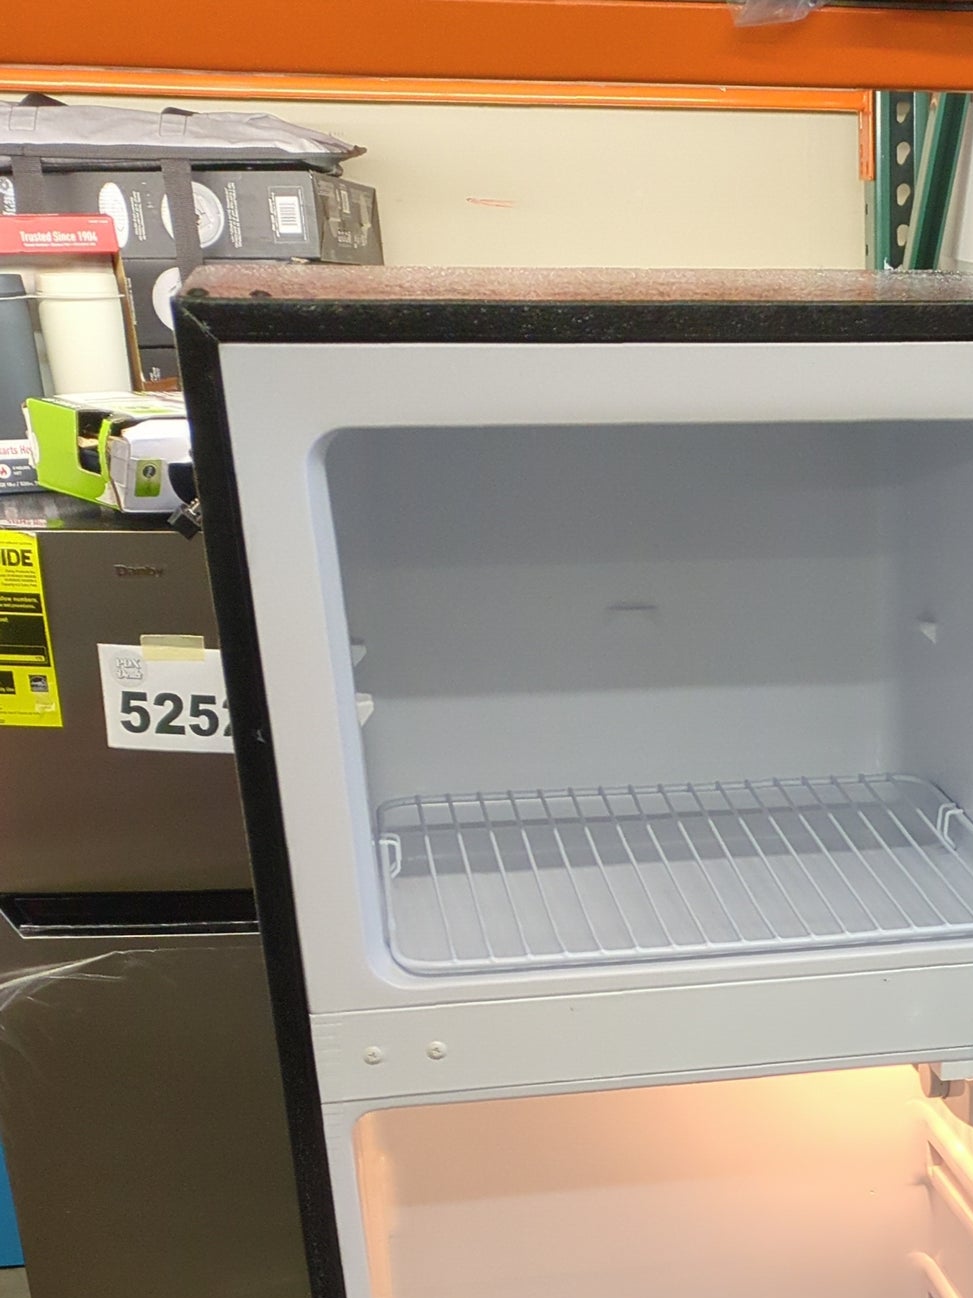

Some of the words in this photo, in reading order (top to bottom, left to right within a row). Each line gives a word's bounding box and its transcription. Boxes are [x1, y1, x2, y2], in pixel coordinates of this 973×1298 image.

[20, 231, 51, 243] Trusted
[52, 230, 76, 243] Since
[77, 230, 98, 242] 1904
